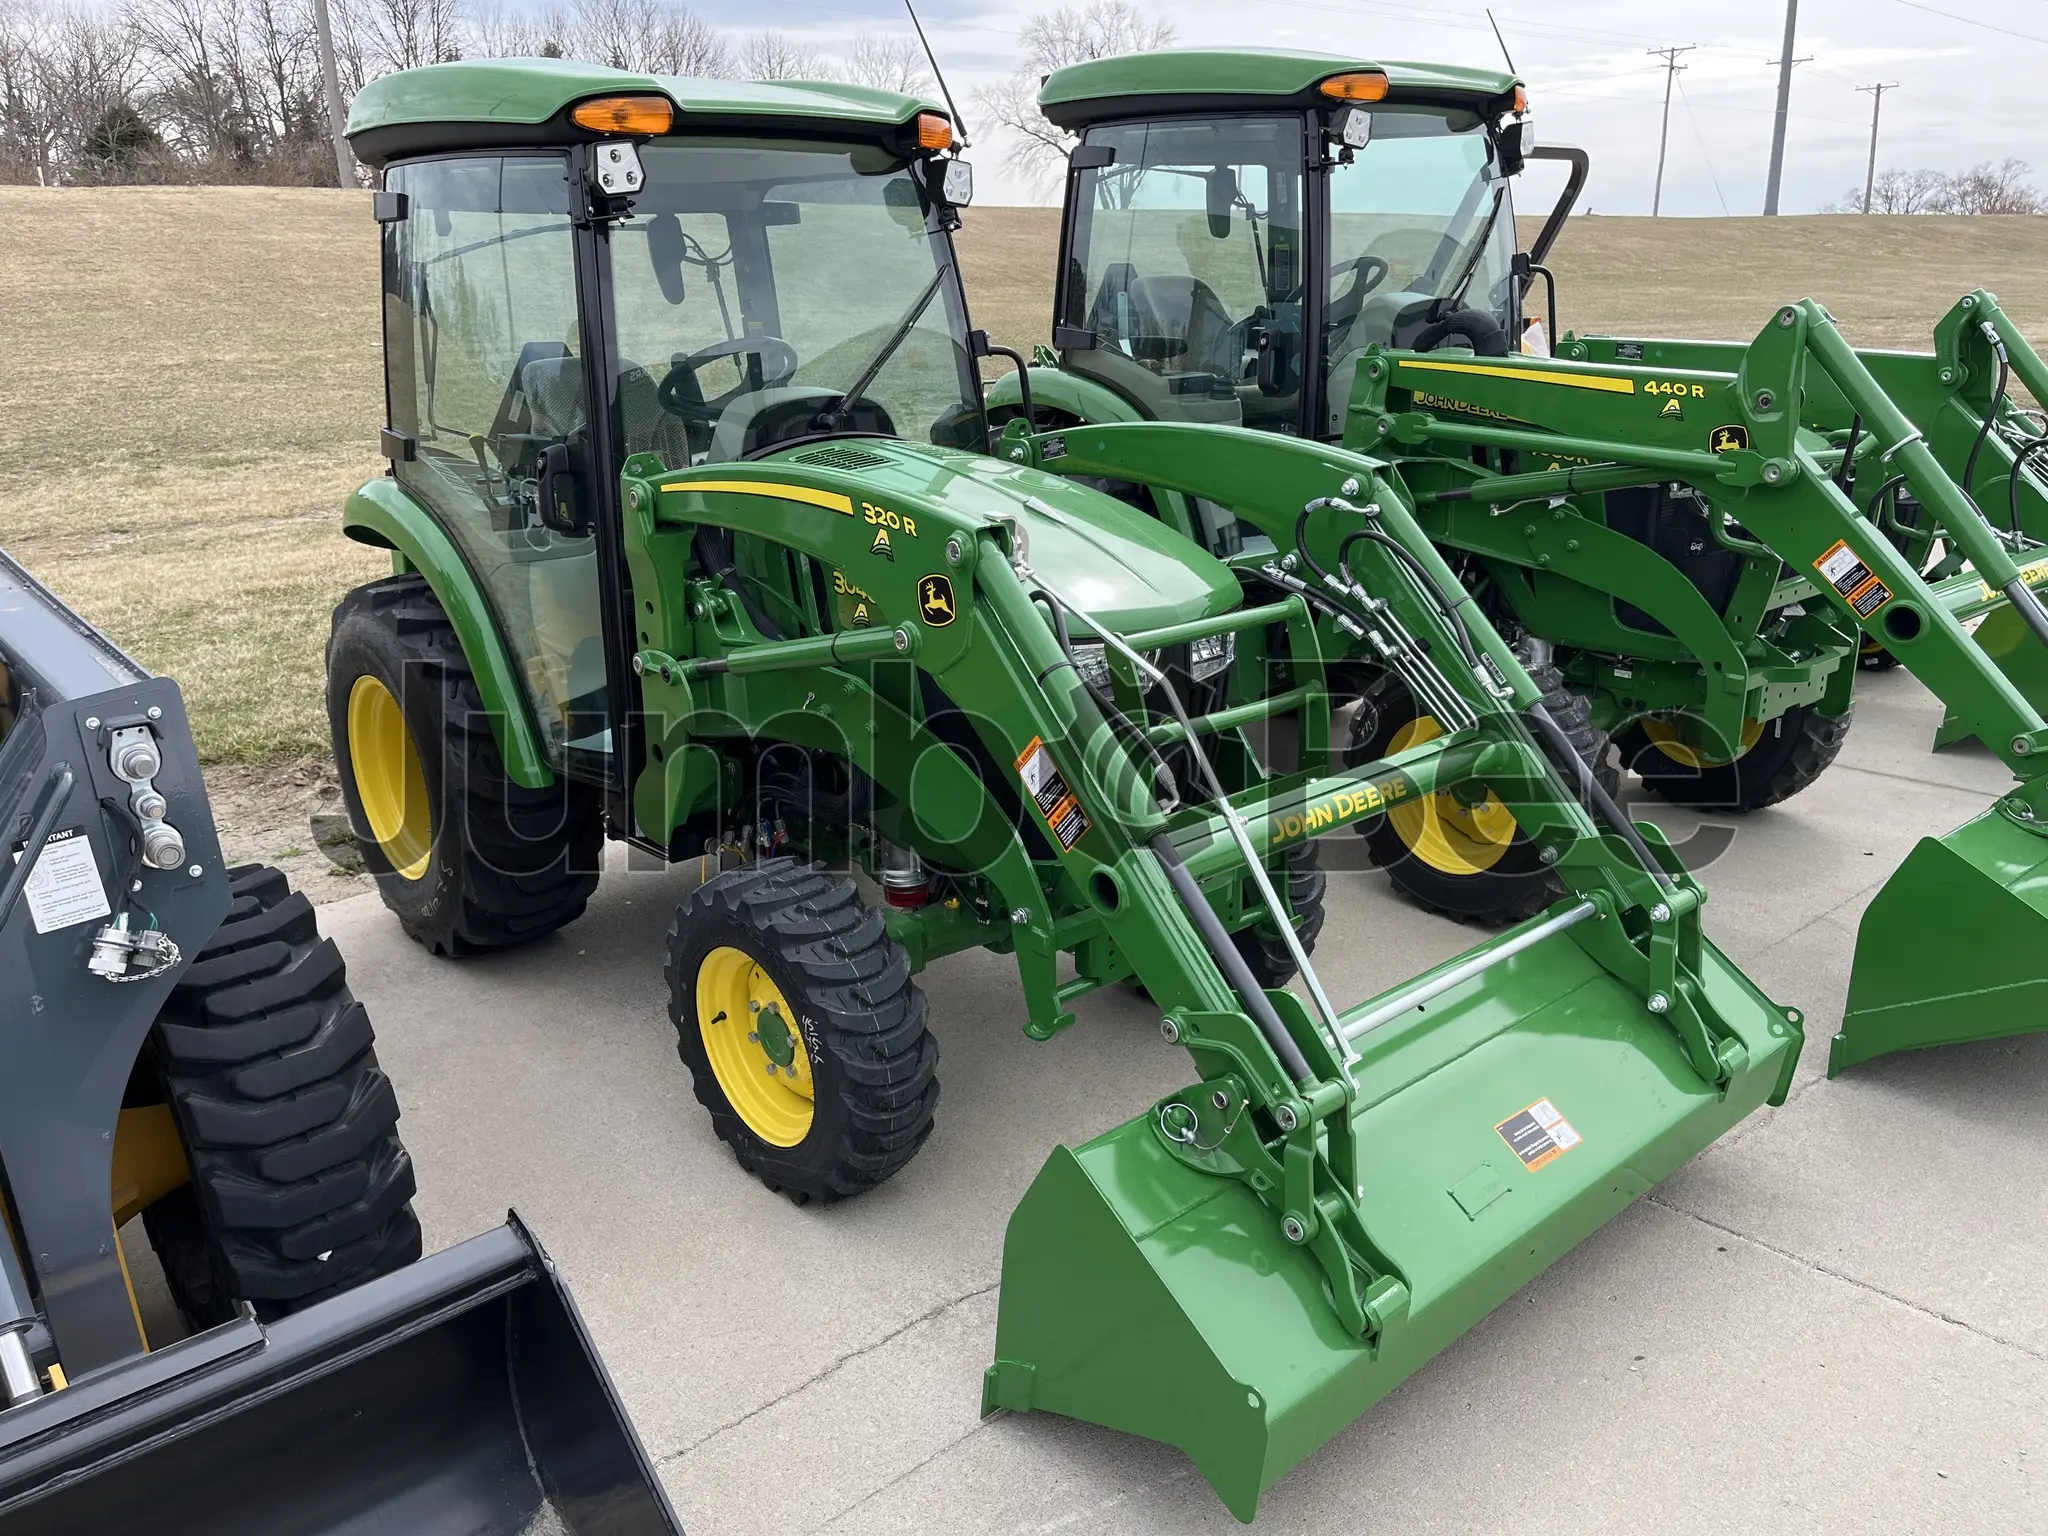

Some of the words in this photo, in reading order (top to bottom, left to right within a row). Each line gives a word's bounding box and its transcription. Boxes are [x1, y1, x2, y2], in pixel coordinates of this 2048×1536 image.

[1417, 391, 1457, 411] JOHN
[1643, 380, 1688, 397] 440
[1691, 384, 1705, 399] R
[861, 501, 901, 530] 320
[902, 515, 919, 538] R
[1272, 803, 1333, 844] JOHN
[1332, 777, 1407, 820] DEERE
